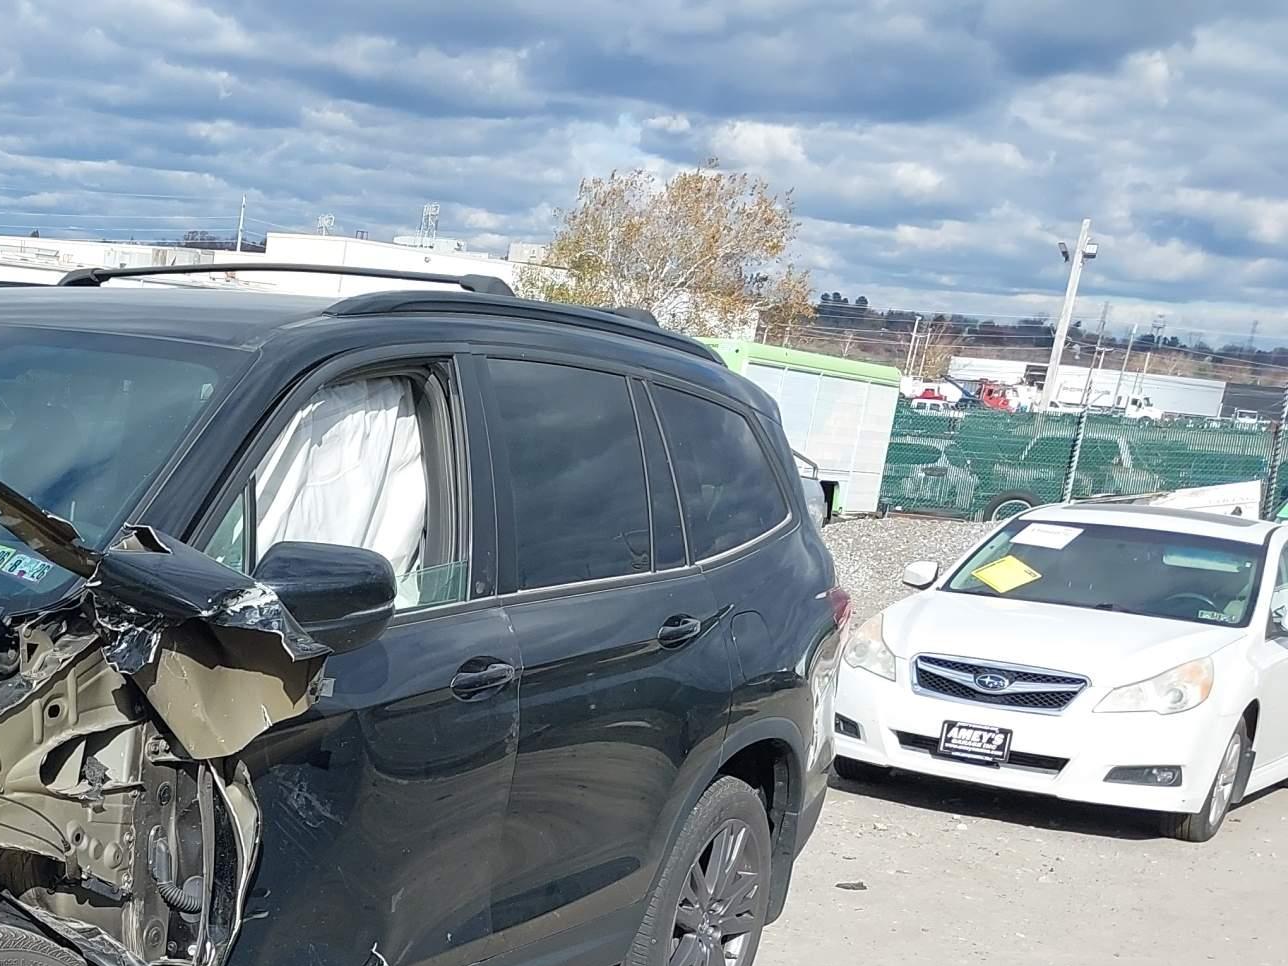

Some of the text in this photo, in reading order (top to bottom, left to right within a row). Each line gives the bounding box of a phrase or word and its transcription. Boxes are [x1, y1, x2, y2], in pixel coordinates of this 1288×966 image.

[8, 559, 51, 580] 8 26
[947, 726, 1005, 746] AMEY'S
